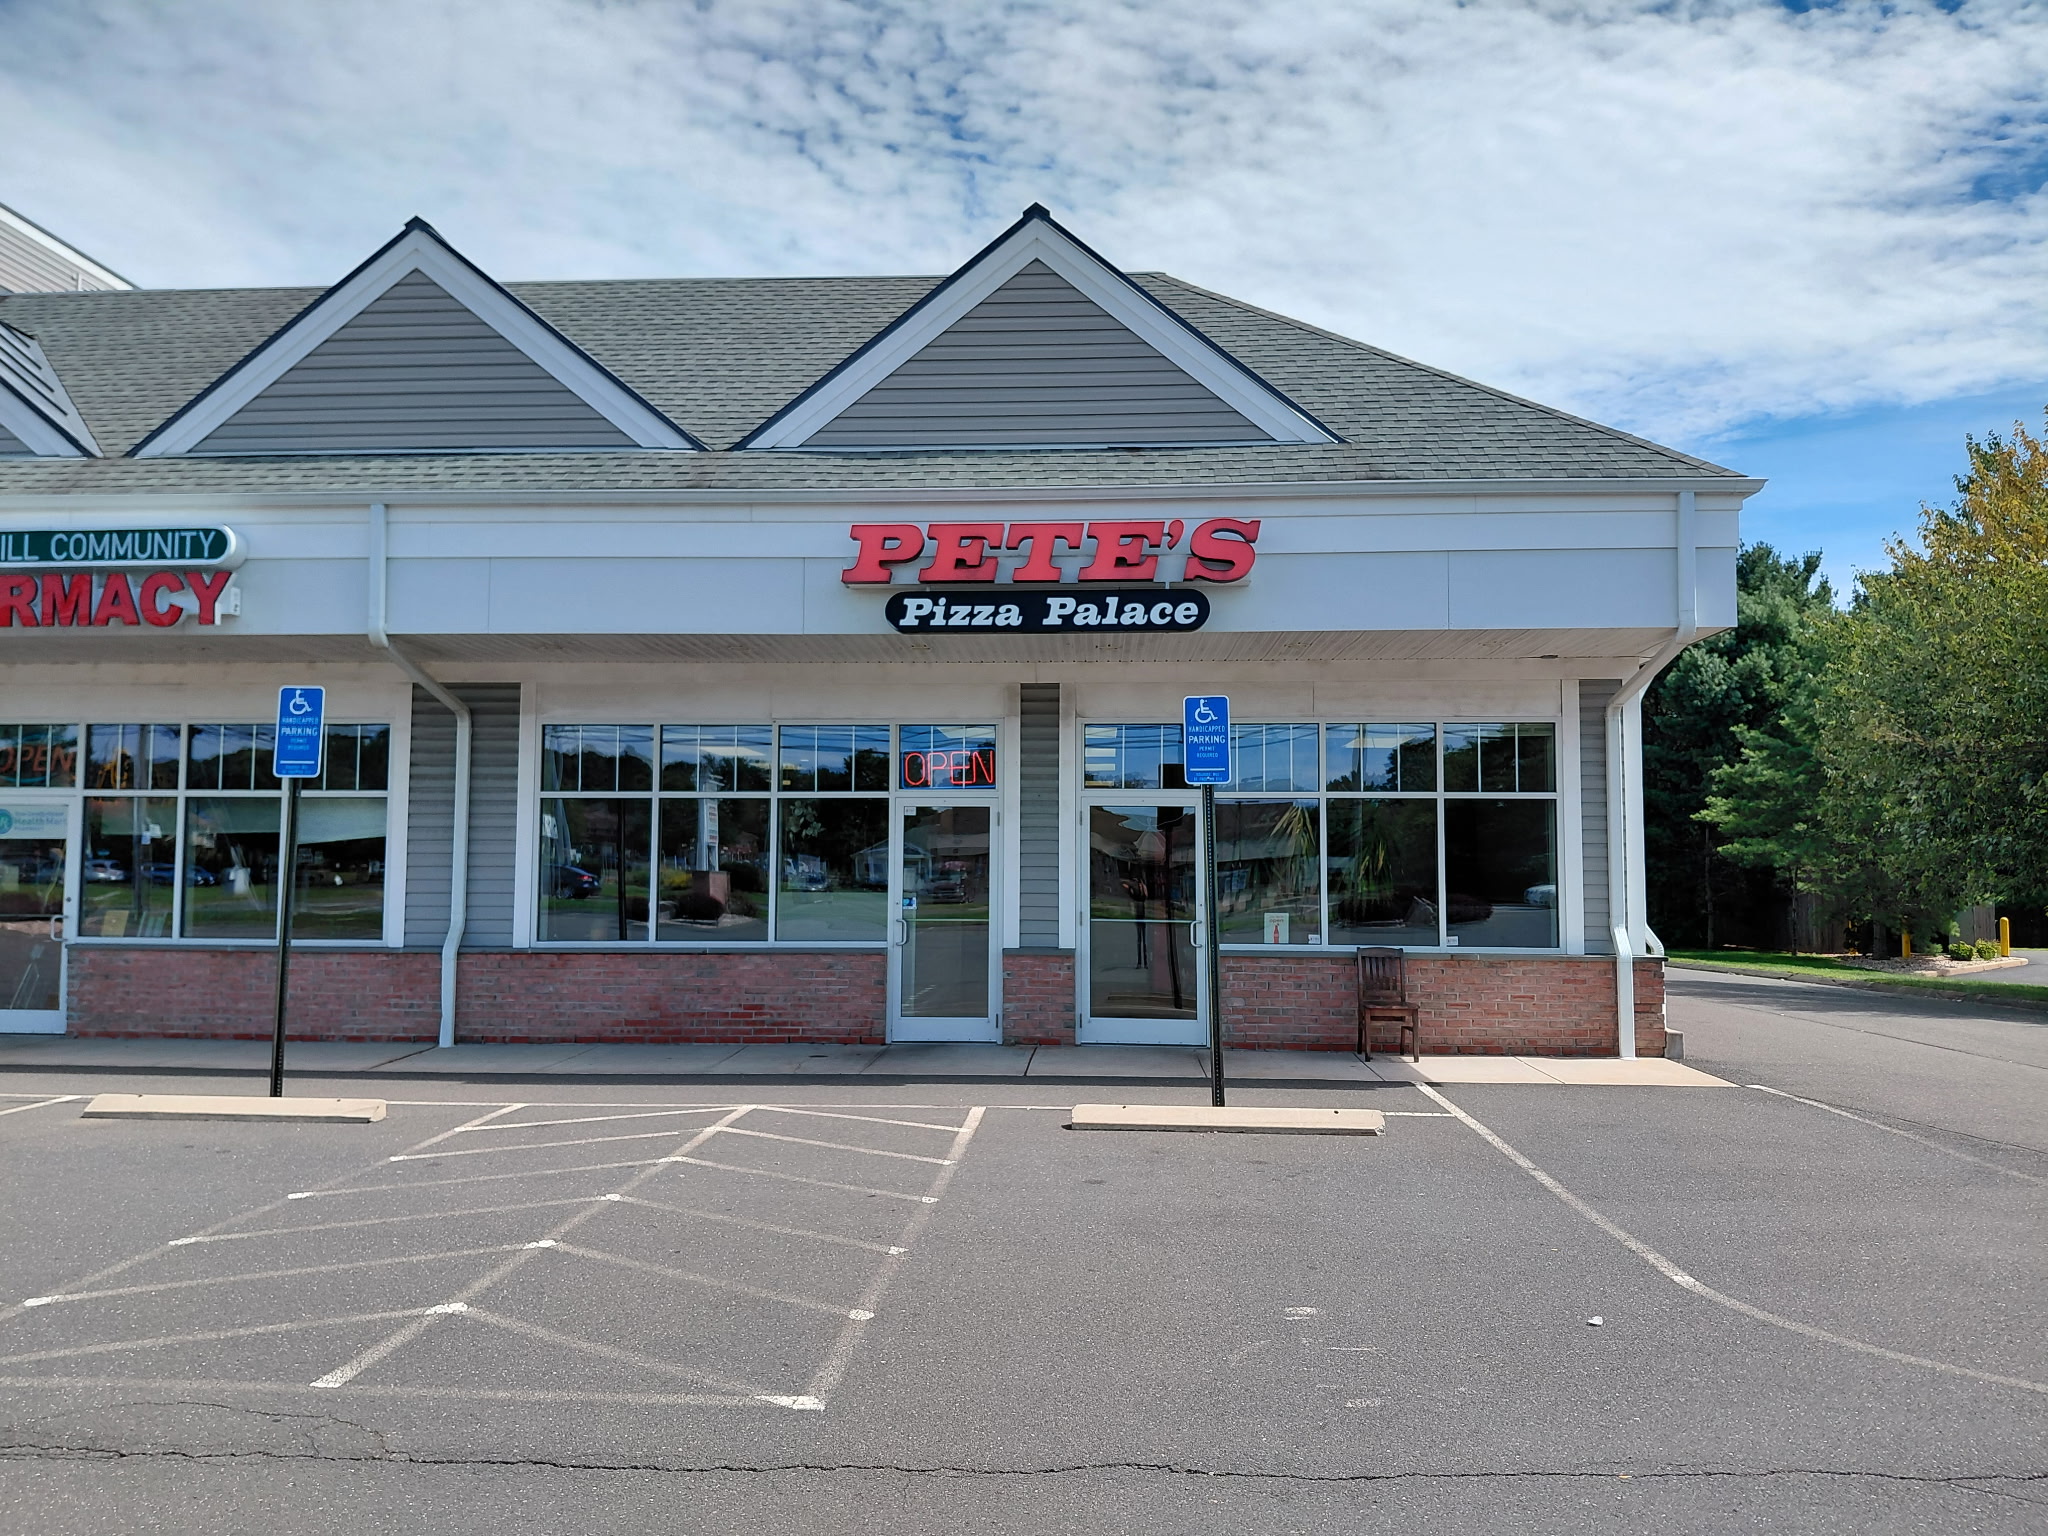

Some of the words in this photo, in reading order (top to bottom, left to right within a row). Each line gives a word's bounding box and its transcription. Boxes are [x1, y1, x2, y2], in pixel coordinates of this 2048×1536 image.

[50, 530, 216, 561] COMMUNITY
[841, 518, 1261, 584] PETE'S
[0, 571, 232, 628] RMACY
[899, 597, 1023, 627] Pizza
[1041, 596, 1199, 627] Palace
[281, 727, 318, 737] PARKING
[1188, 725, 1226, 733] HANDICAPPED
[1188, 735, 1226, 745] PARKING
[904, 749, 994, 786] OPEN
